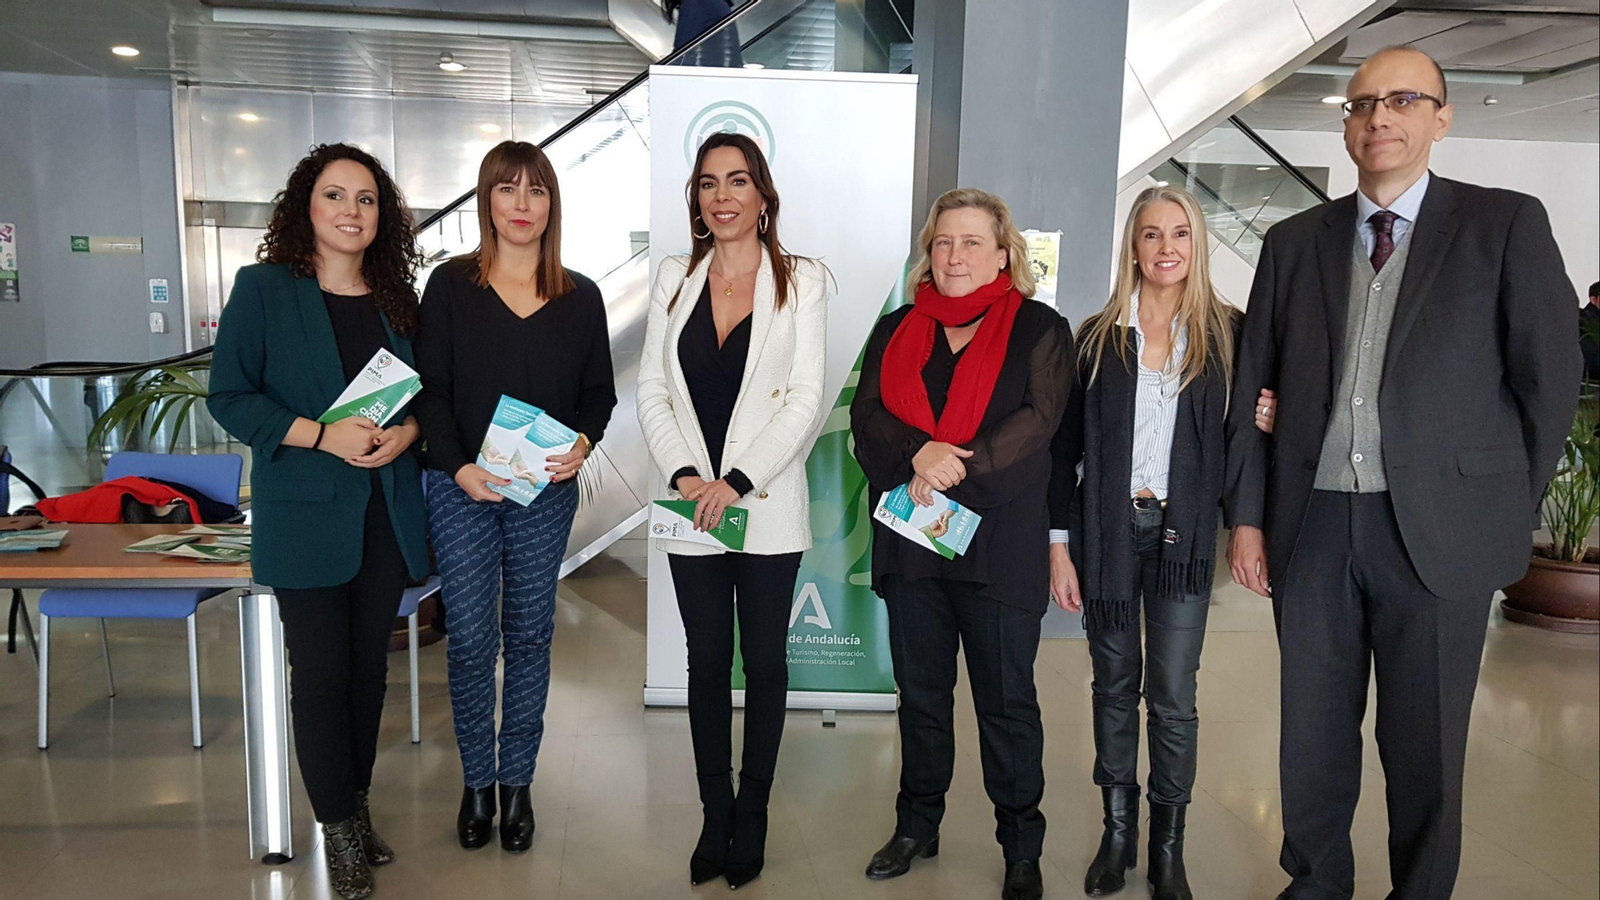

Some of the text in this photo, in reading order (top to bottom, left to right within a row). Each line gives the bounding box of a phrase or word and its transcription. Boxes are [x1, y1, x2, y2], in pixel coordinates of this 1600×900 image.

[367, 366, 383, 379] PIMA
[369, 406, 383, 418] DIA
[374, 401, 388, 413] ME
[788, 633, 861, 645] de Andalucía
[792, 648, 820, 656] Turismo,
[820, 650, 867, 658] Regeneración,
[788, 657, 837, 665] Administración
